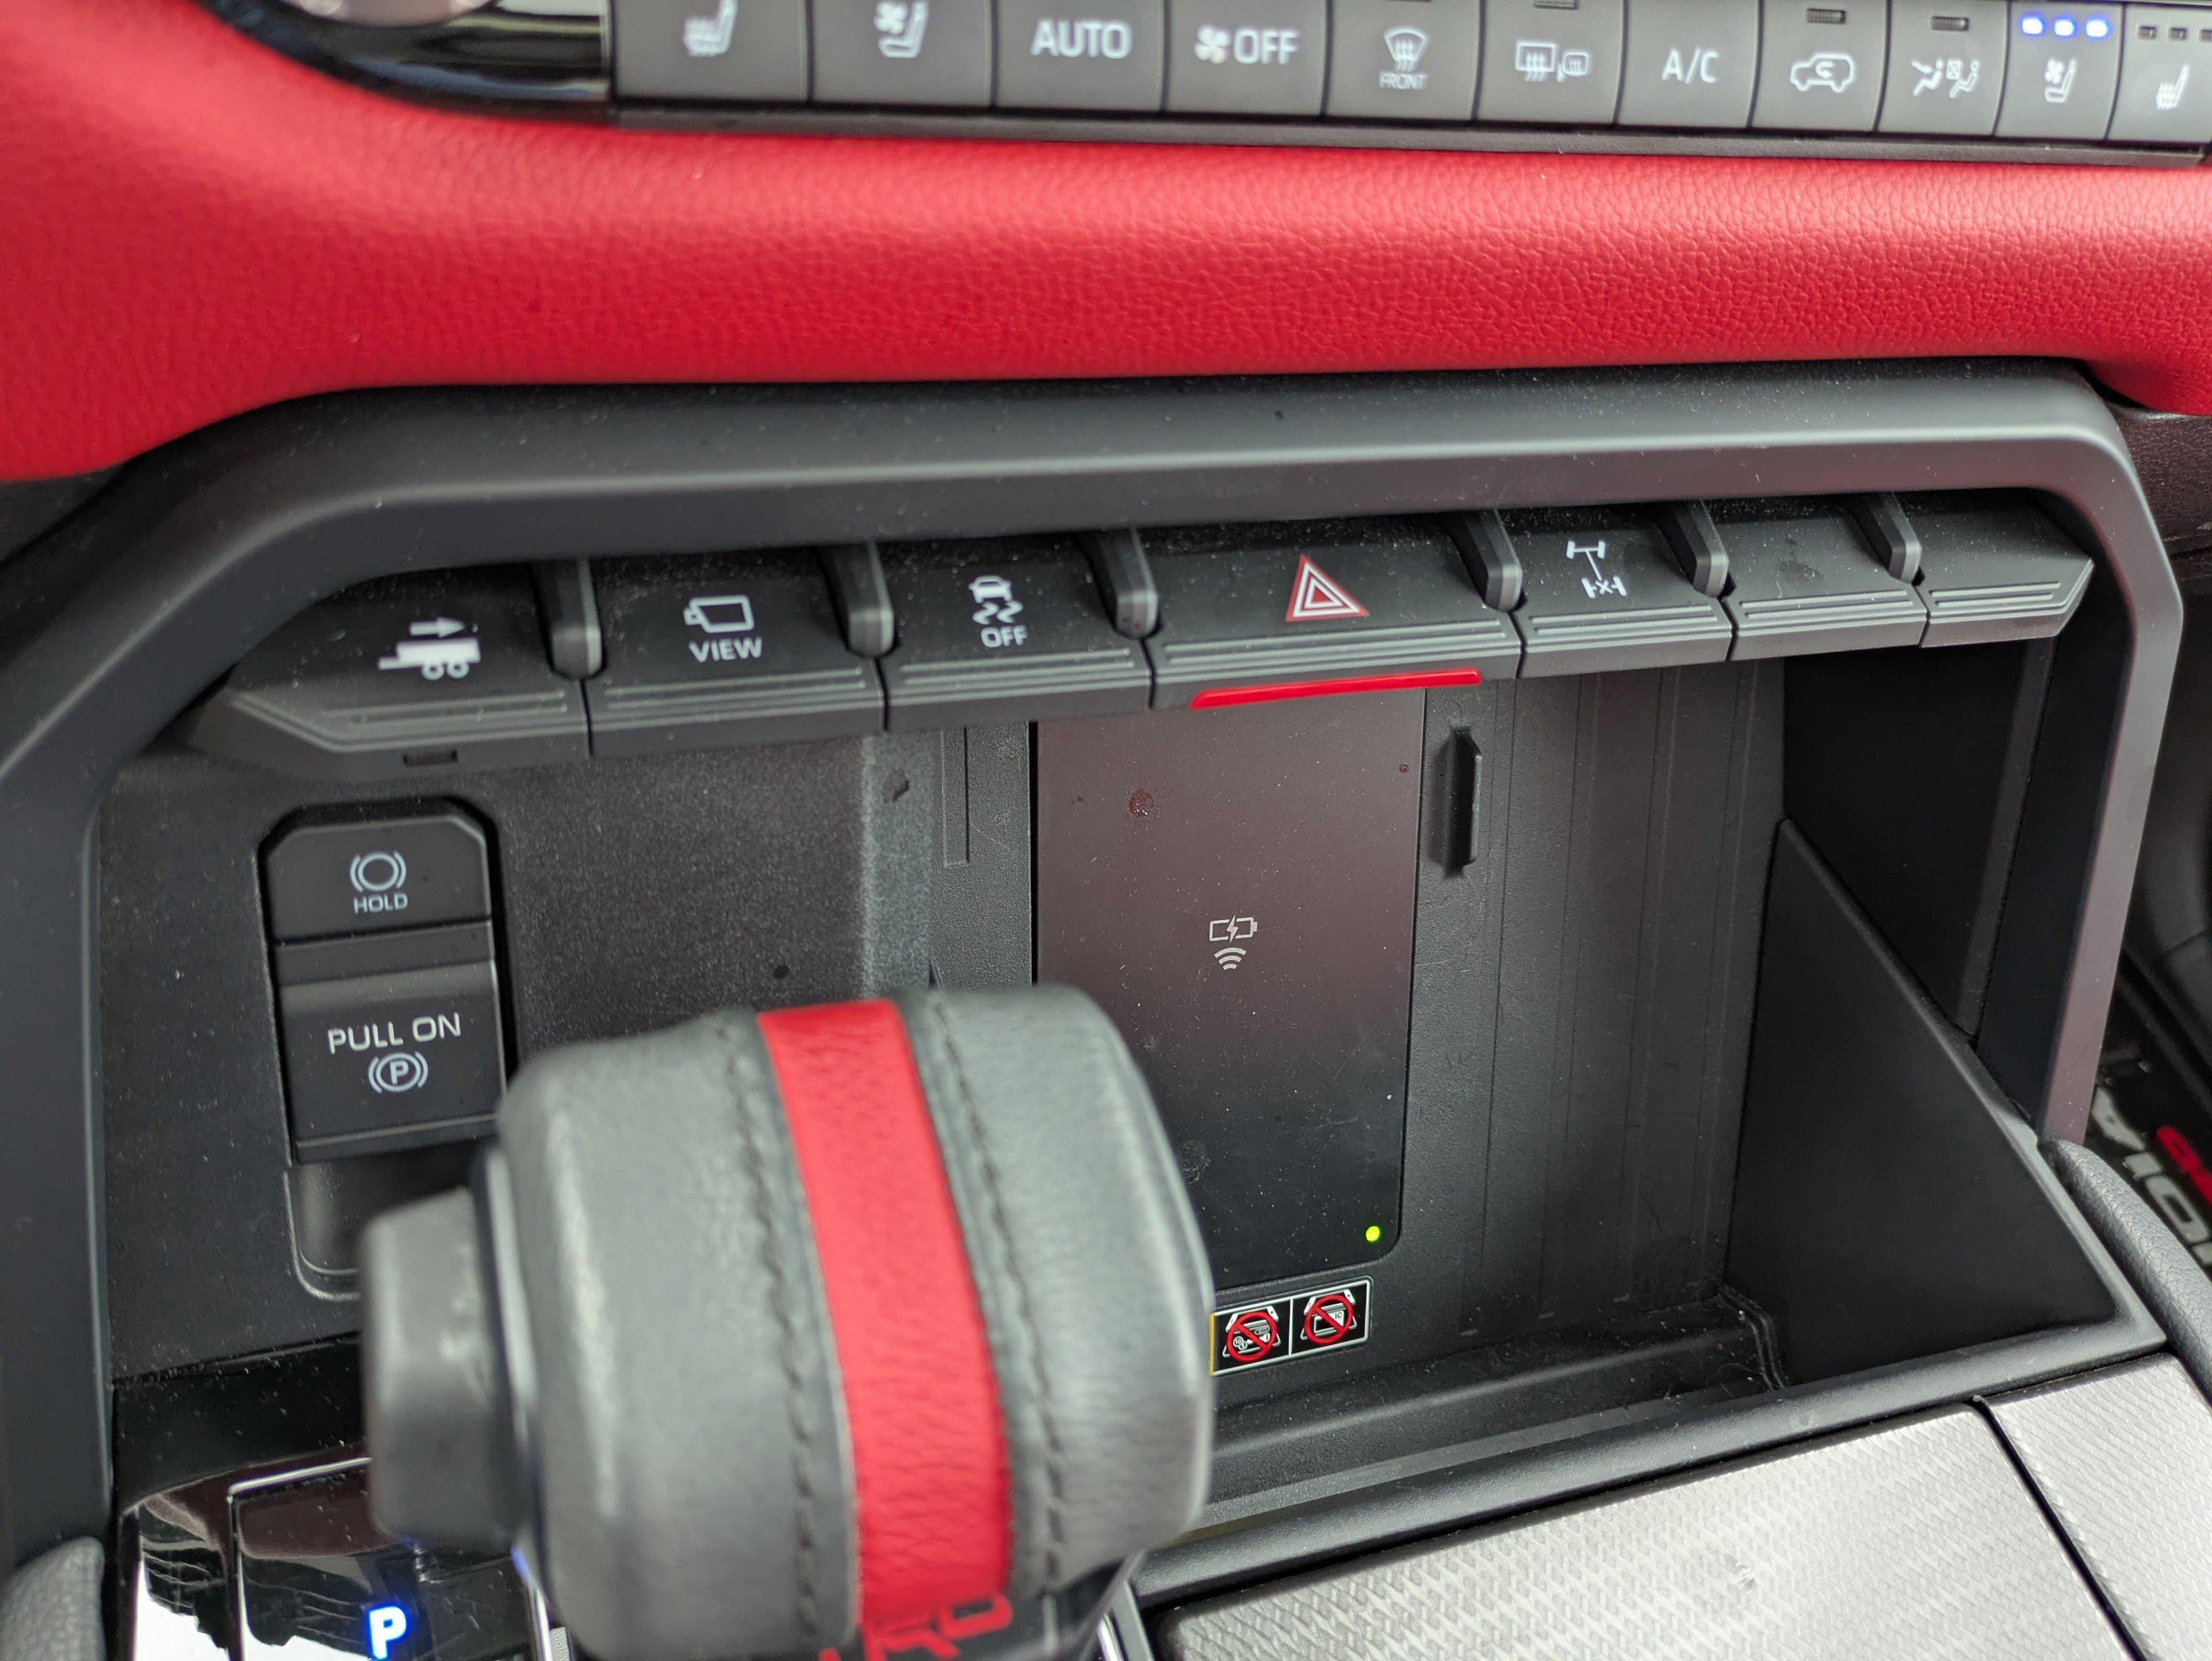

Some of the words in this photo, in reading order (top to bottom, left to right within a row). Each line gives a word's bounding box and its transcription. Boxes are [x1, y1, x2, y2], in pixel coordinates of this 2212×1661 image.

[1031, 19, 1132, 59] AUTO
[1234, 27, 1299, 65] OFF
[1380, 71, 1428, 90] FRONT
[1661, 46, 1720, 84] A/C
[689, 636, 763, 663] VIEW
[981, 625, 1028, 648] OFF
[353, 892, 408, 914] HOLD
[328, 1021, 404, 1054] PULL
[412, 1012, 462, 1042] ON
[390, 1061, 409, 1085] P
[369, 1606, 407, 1659] P
